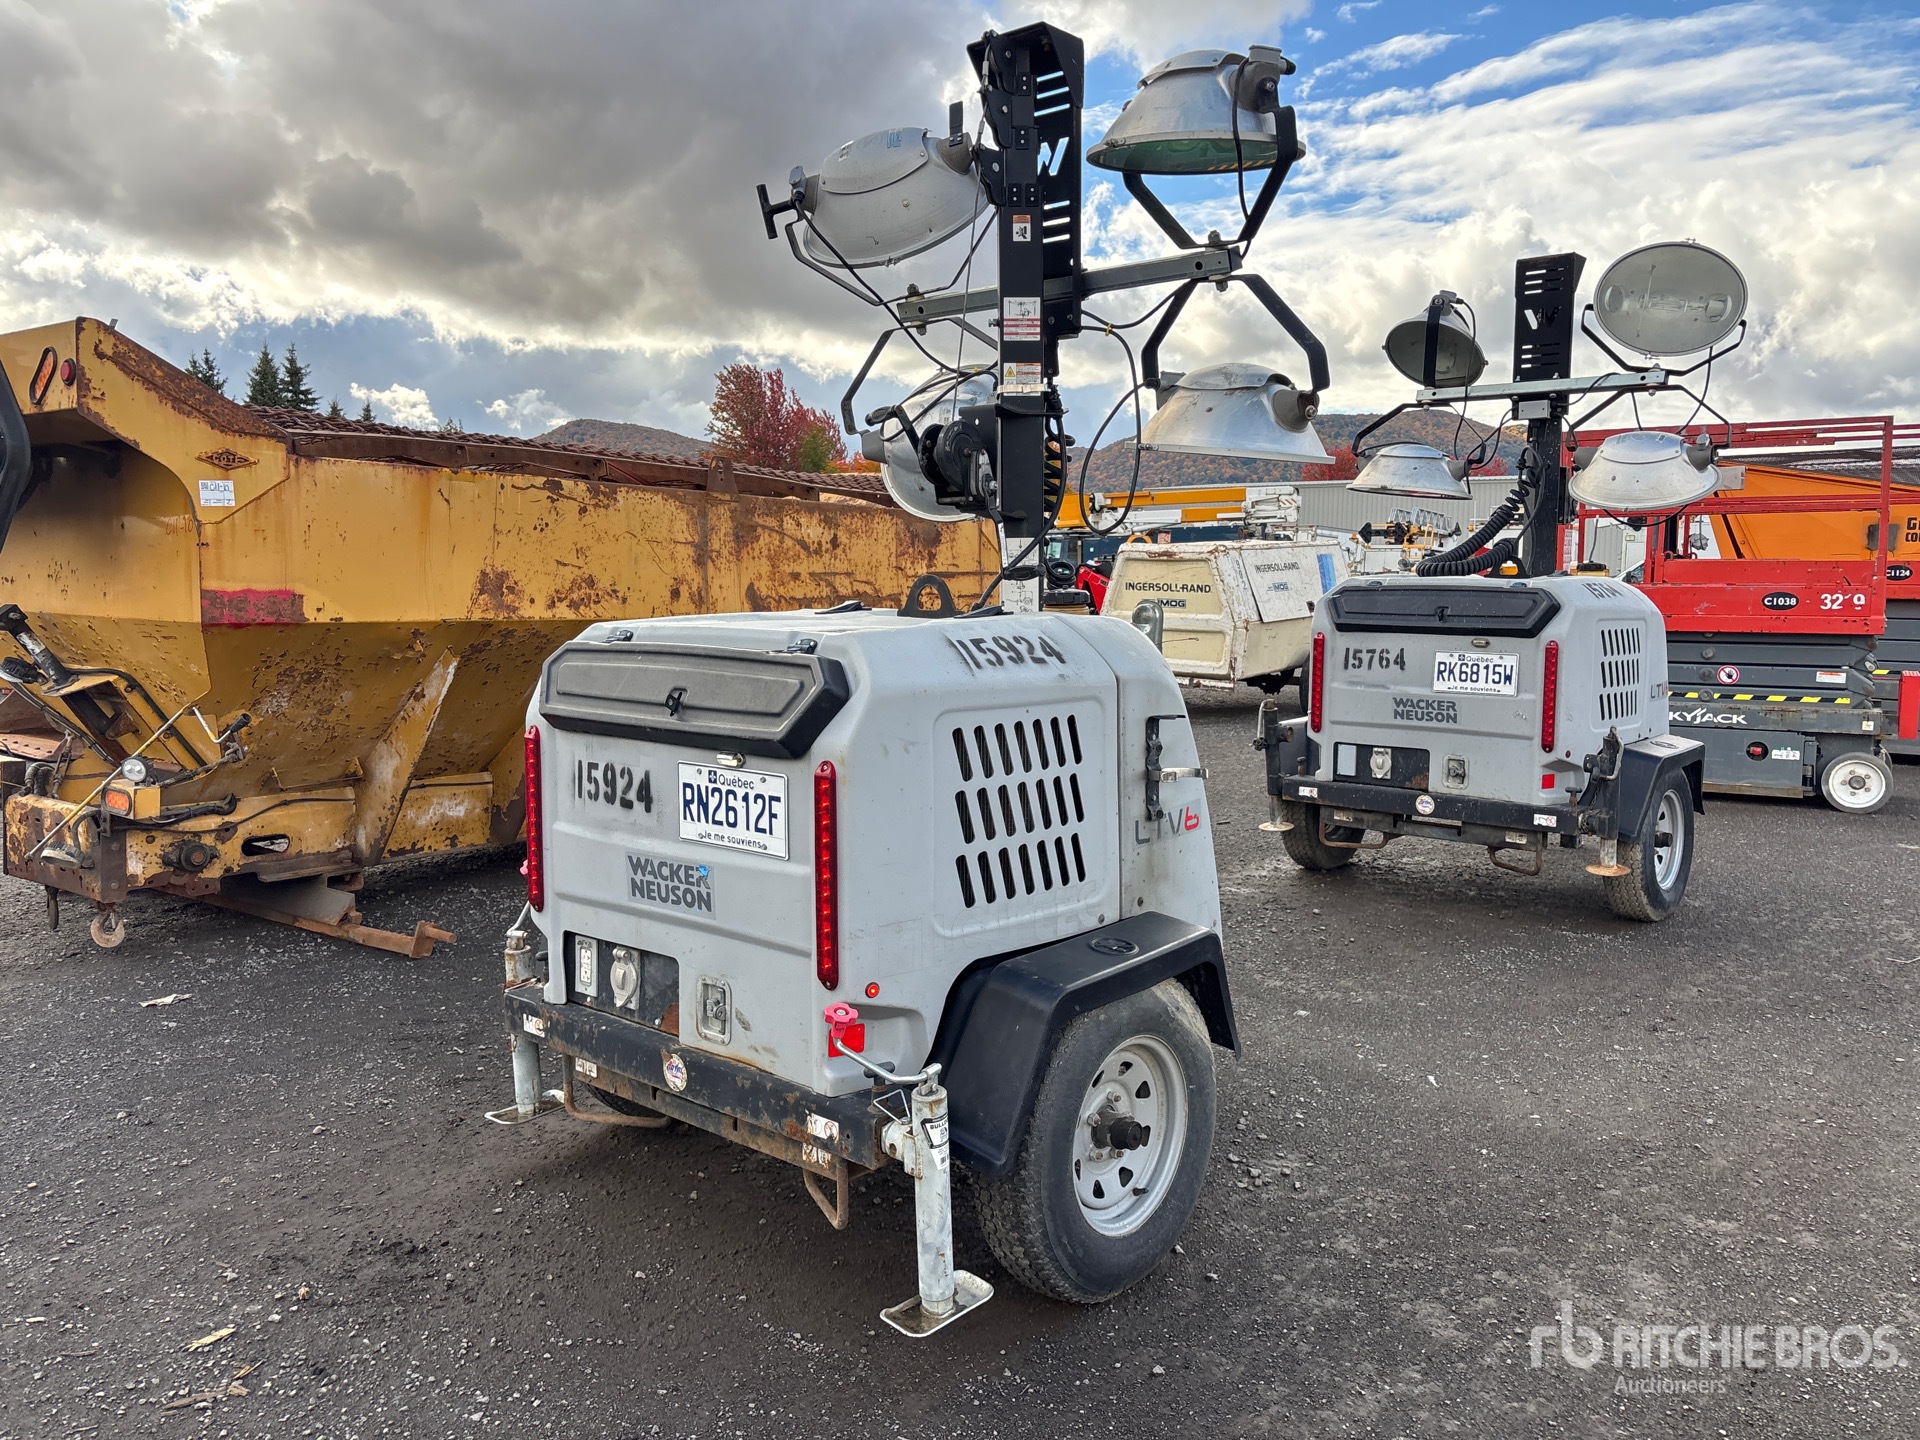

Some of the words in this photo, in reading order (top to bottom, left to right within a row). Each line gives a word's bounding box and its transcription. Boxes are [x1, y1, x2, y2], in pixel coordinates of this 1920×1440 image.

[1905, 532, 1920, 543] CO
[1254, 562, 1300, 573] INGERSOLL-RAND
[1125, 582, 1212, 594] INGERSOLL-RAND
[1764, 597, 1797, 606] C1038
[955, 635, 1067, 670] 15924
[1343, 647, 1407, 672] 15764
[1466, 655, 1494, 663] Québec
[1436, 661, 1514, 686] RK6815W
[1392, 697, 1458, 712] WACKER
[1393, 708, 1458, 724] NEUSON
[576, 759, 653, 814] 15924
[718, 773, 755, 790] Québec
[682, 782, 782, 836] RN2612F
[703, 829, 712, 839] Je
[713, 833, 726, 842] me
[727, 835, 762, 849] souviens
[627, 854, 711, 890] WACKER
[630, 877, 712, 913] NEUSON
